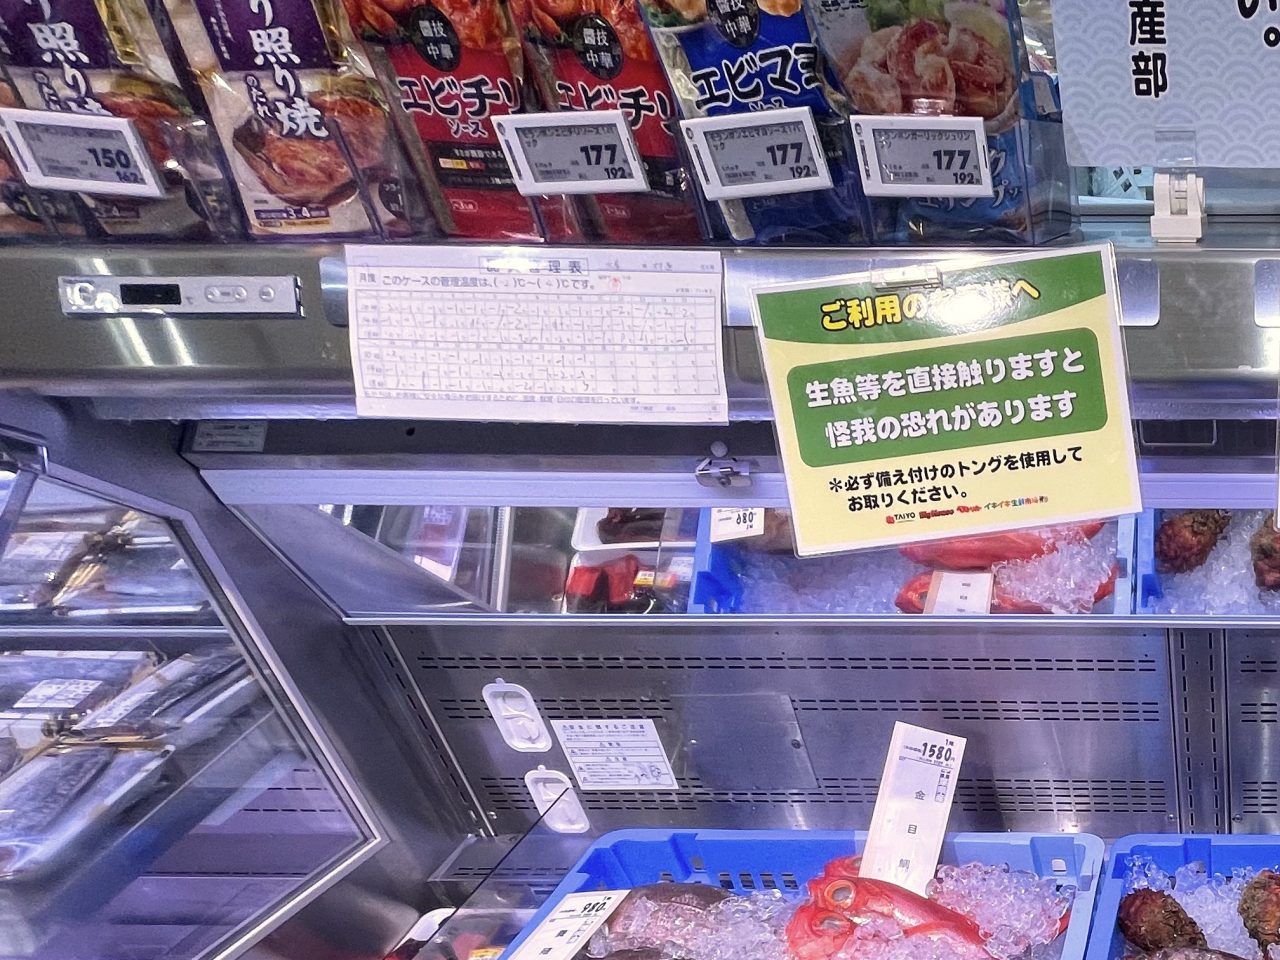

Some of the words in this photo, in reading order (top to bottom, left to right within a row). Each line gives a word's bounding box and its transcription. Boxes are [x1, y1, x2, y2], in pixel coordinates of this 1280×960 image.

[448, 118, 489, 138] ソース
[87, 147, 131, 170] 150
[580, 143, 618, 166] 177
[766, 142, 803, 166] 177
[933, 150, 972, 171] 177
[604, 167, 628, 179] 192
[789, 165, 812, 178] 192
[952, 172, 975, 184] 192
[805, 347, 1085, 408] 生魚等を直接触りますと
[826, 390, 1077, 449] 怪我の恐れがあります
[848, 485, 968, 512] お取りください。
[894, 512, 915, 520] TAIYO
